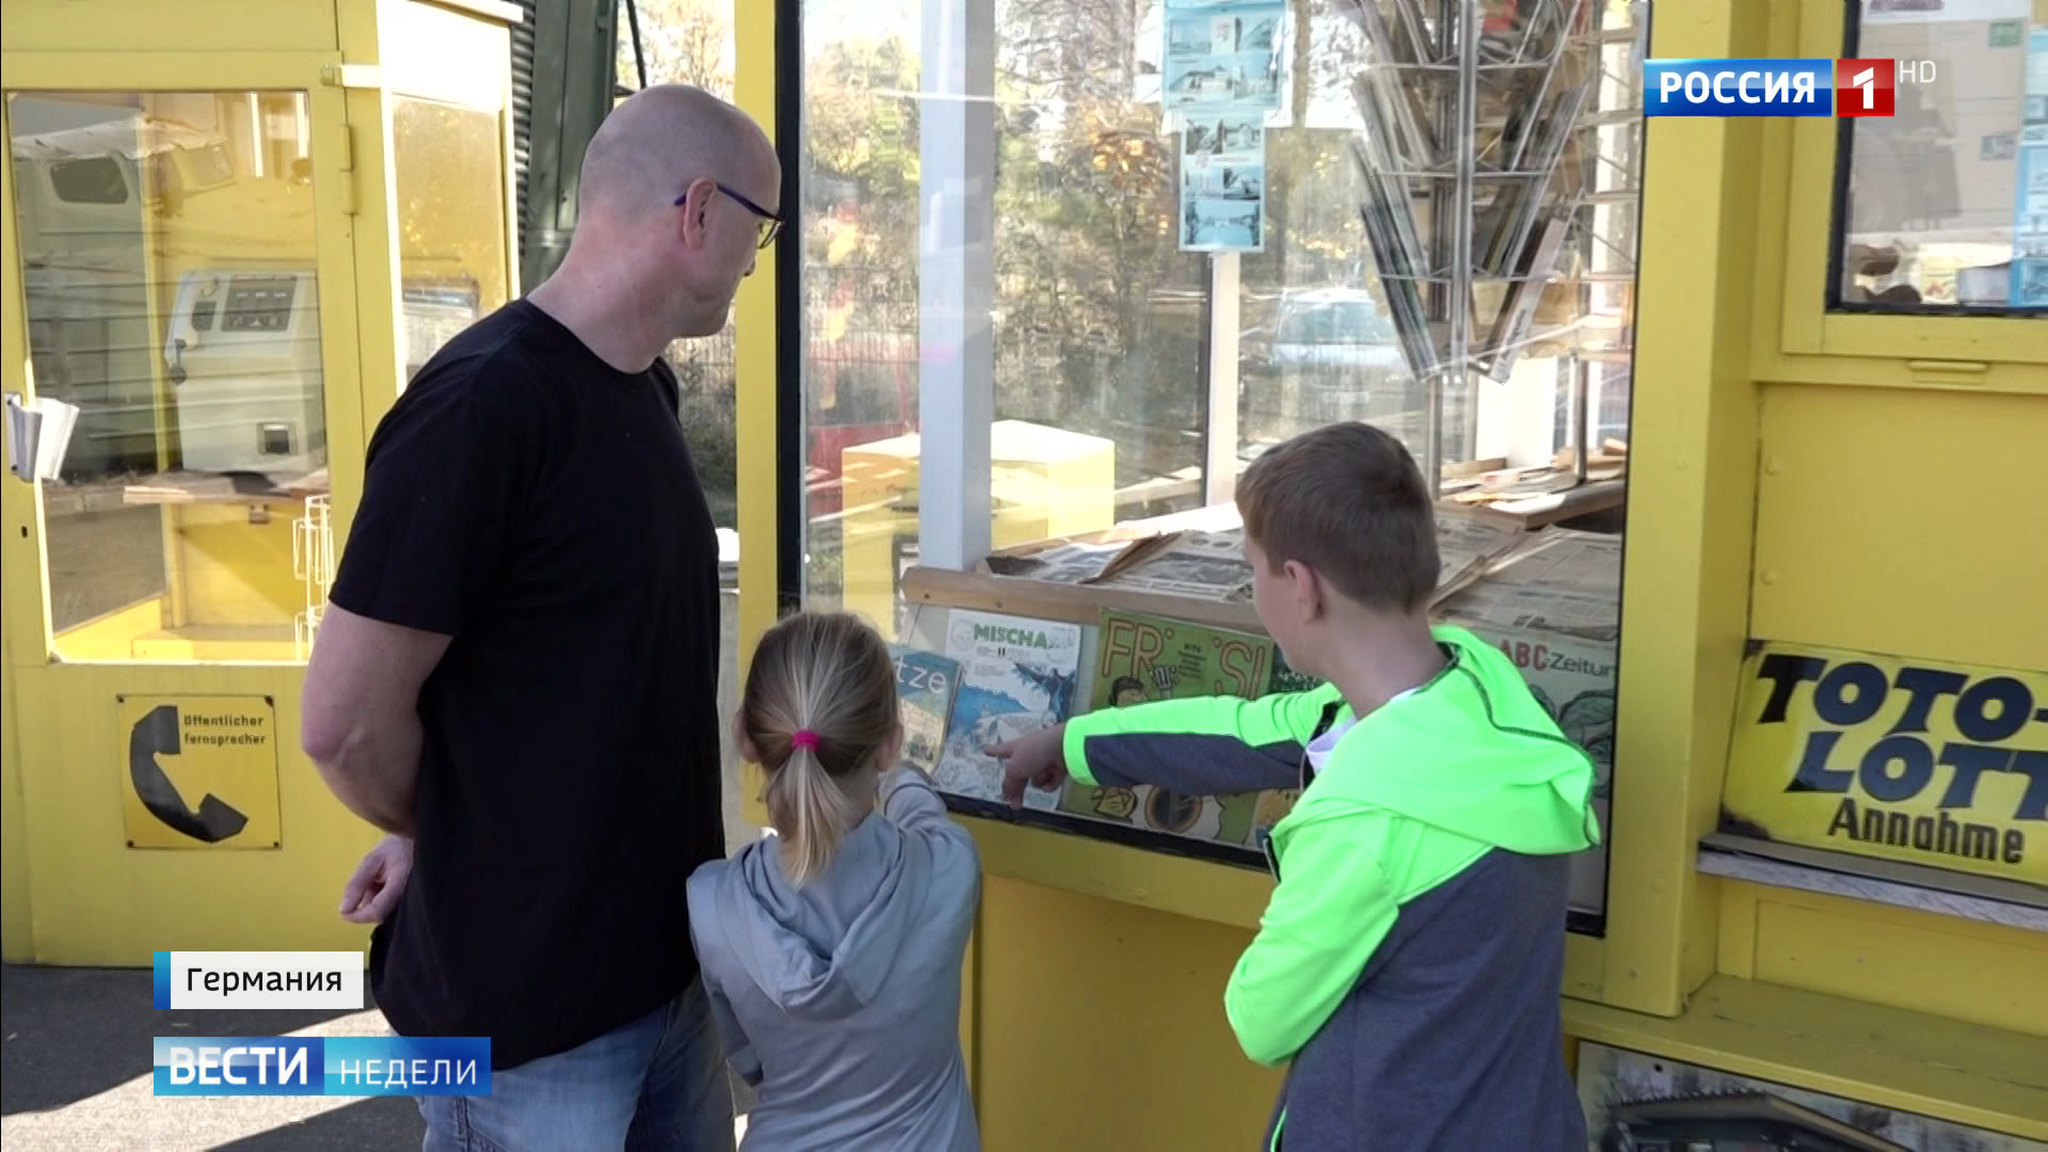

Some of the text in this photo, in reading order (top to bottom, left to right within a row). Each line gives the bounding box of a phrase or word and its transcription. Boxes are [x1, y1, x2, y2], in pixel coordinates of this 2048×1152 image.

[972, 622, 1048, 649] MISCHA
[894, 655, 948, 695] tze
[184, 733, 266, 748] Fernsprecher
[1827, 796, 2025, 866] Annahme
